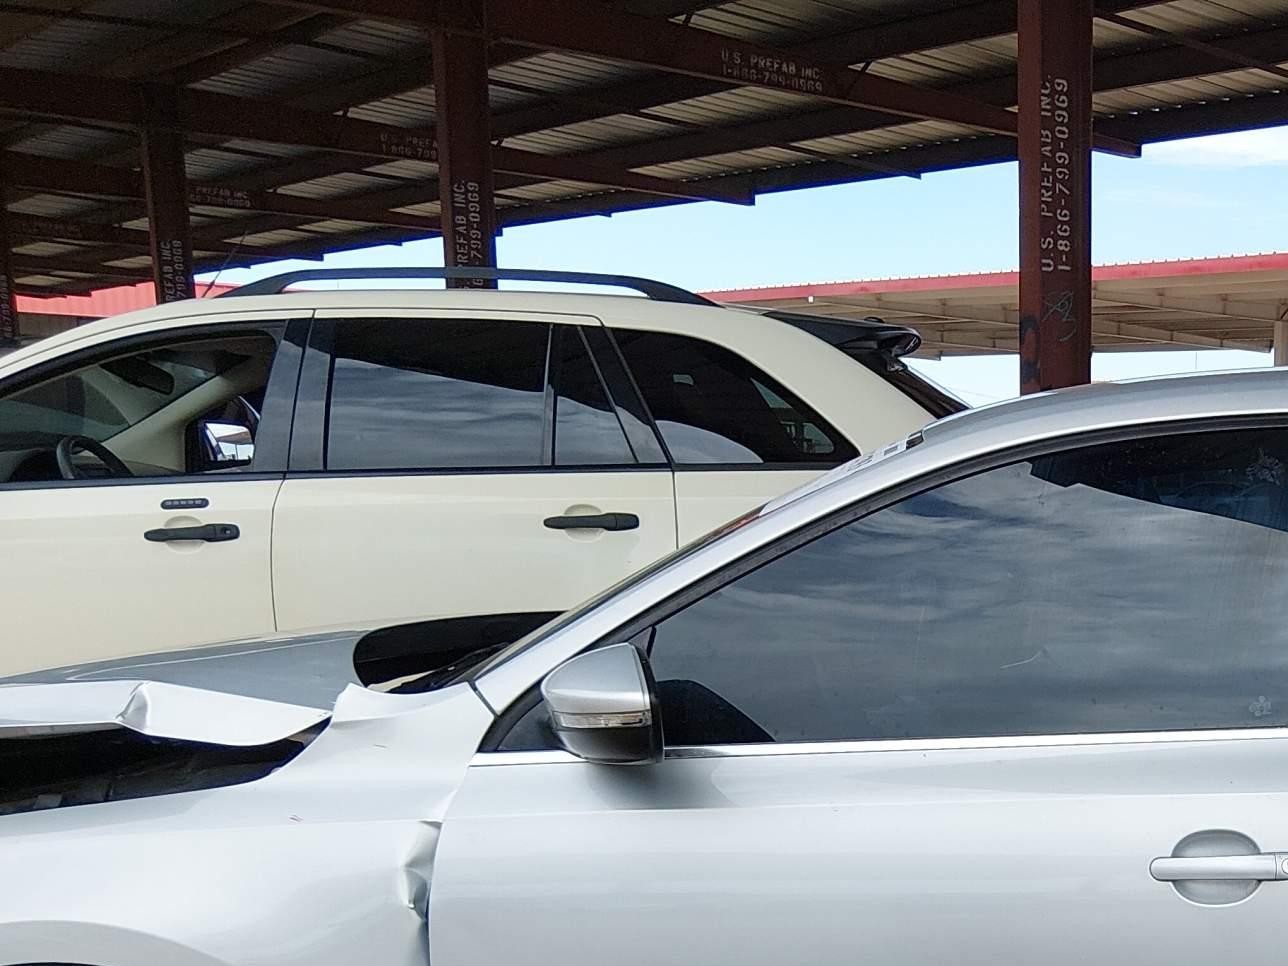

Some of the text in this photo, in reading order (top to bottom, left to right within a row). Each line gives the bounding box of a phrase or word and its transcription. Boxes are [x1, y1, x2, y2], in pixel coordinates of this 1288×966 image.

[750, 54, 796, 75] PREFAB
[452, 180, 469, 267] REFAB INC.
[1041, 74, 1055, 272] U.S. PREFAB INC.
[1054, 78, 1072, 271] 1-866-799-0969
